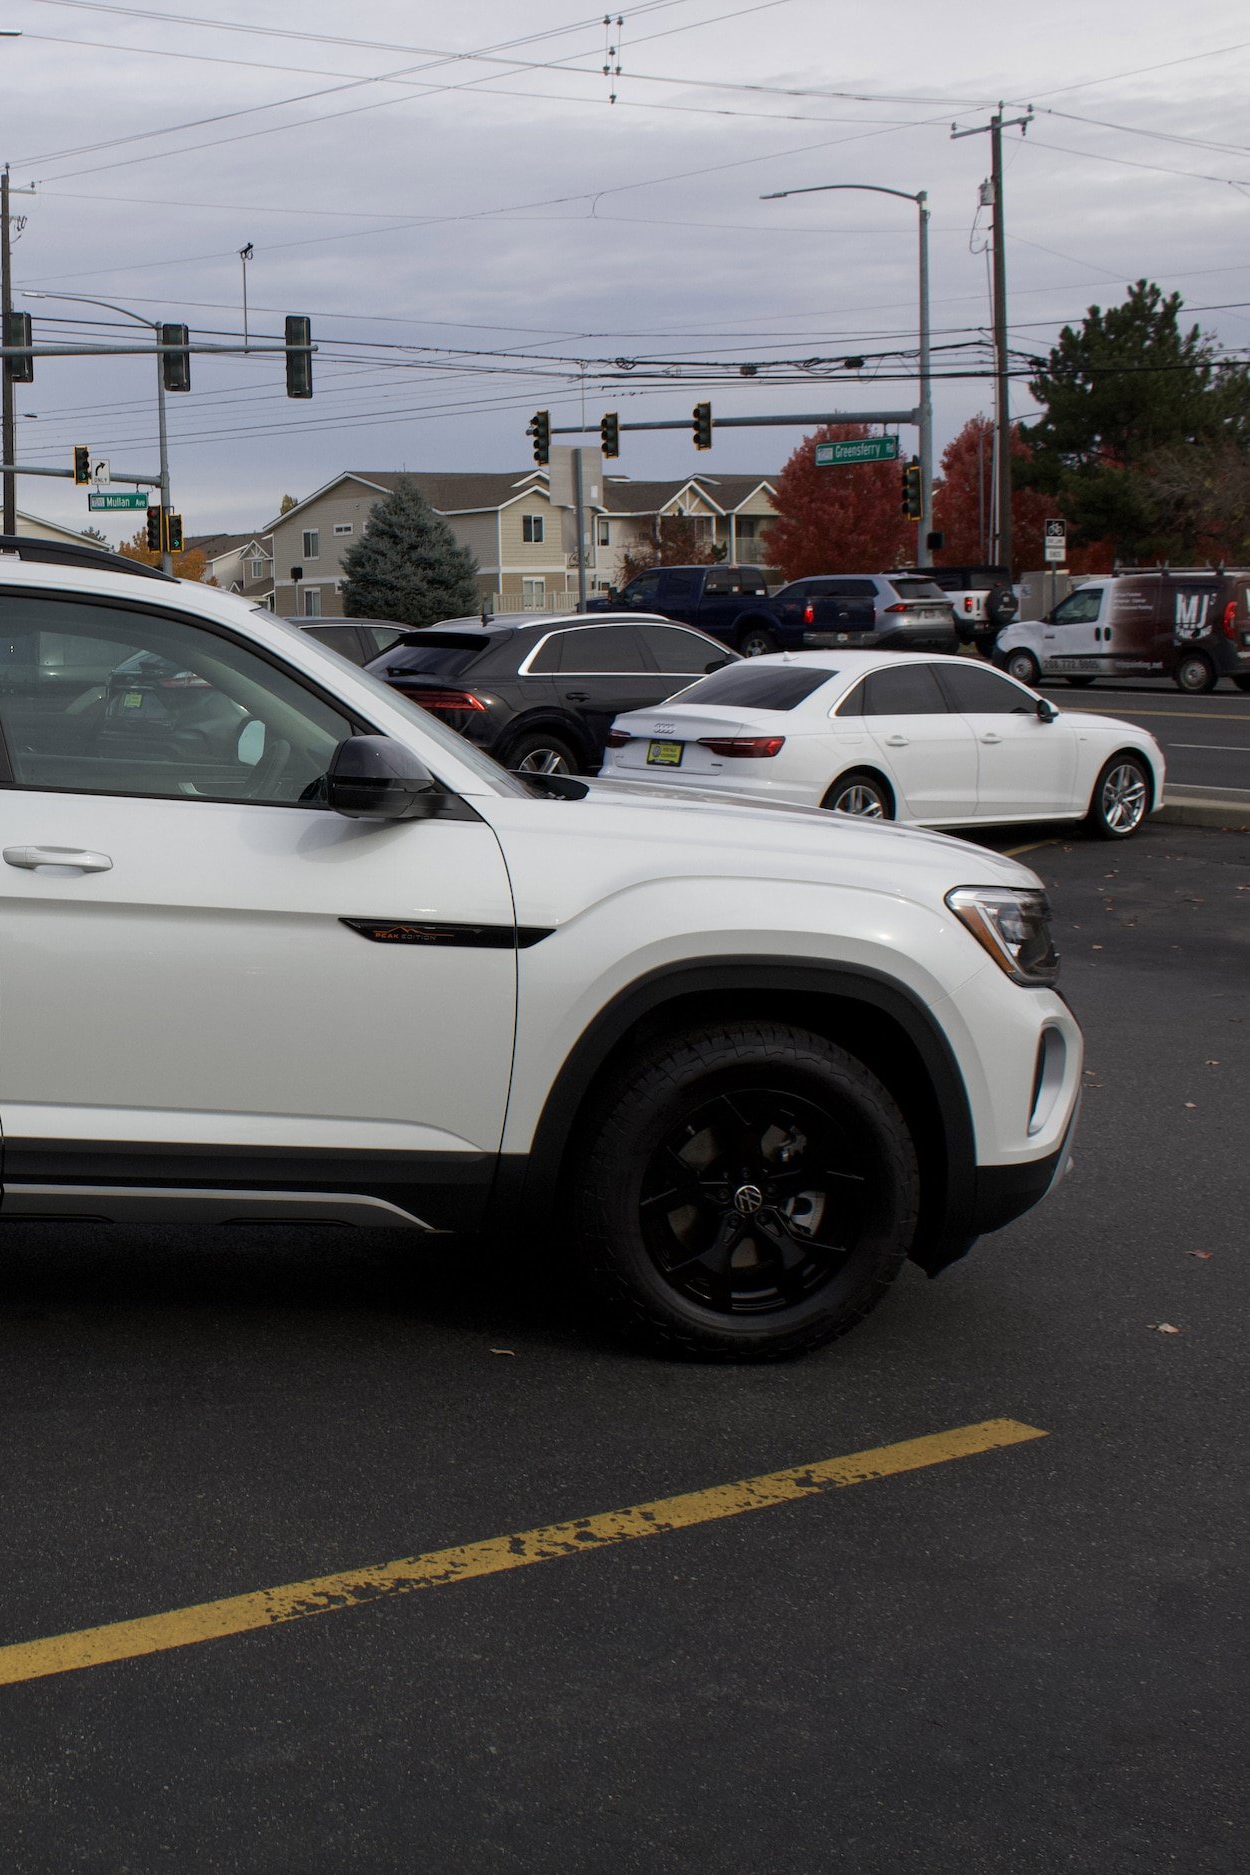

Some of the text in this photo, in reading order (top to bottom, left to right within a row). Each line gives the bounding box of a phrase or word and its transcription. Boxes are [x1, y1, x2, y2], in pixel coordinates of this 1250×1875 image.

[835, 443, 881, 458] Greensferry
[106, 497, 130, 507] Mullan
[135, 498, 146, 507] Ave
